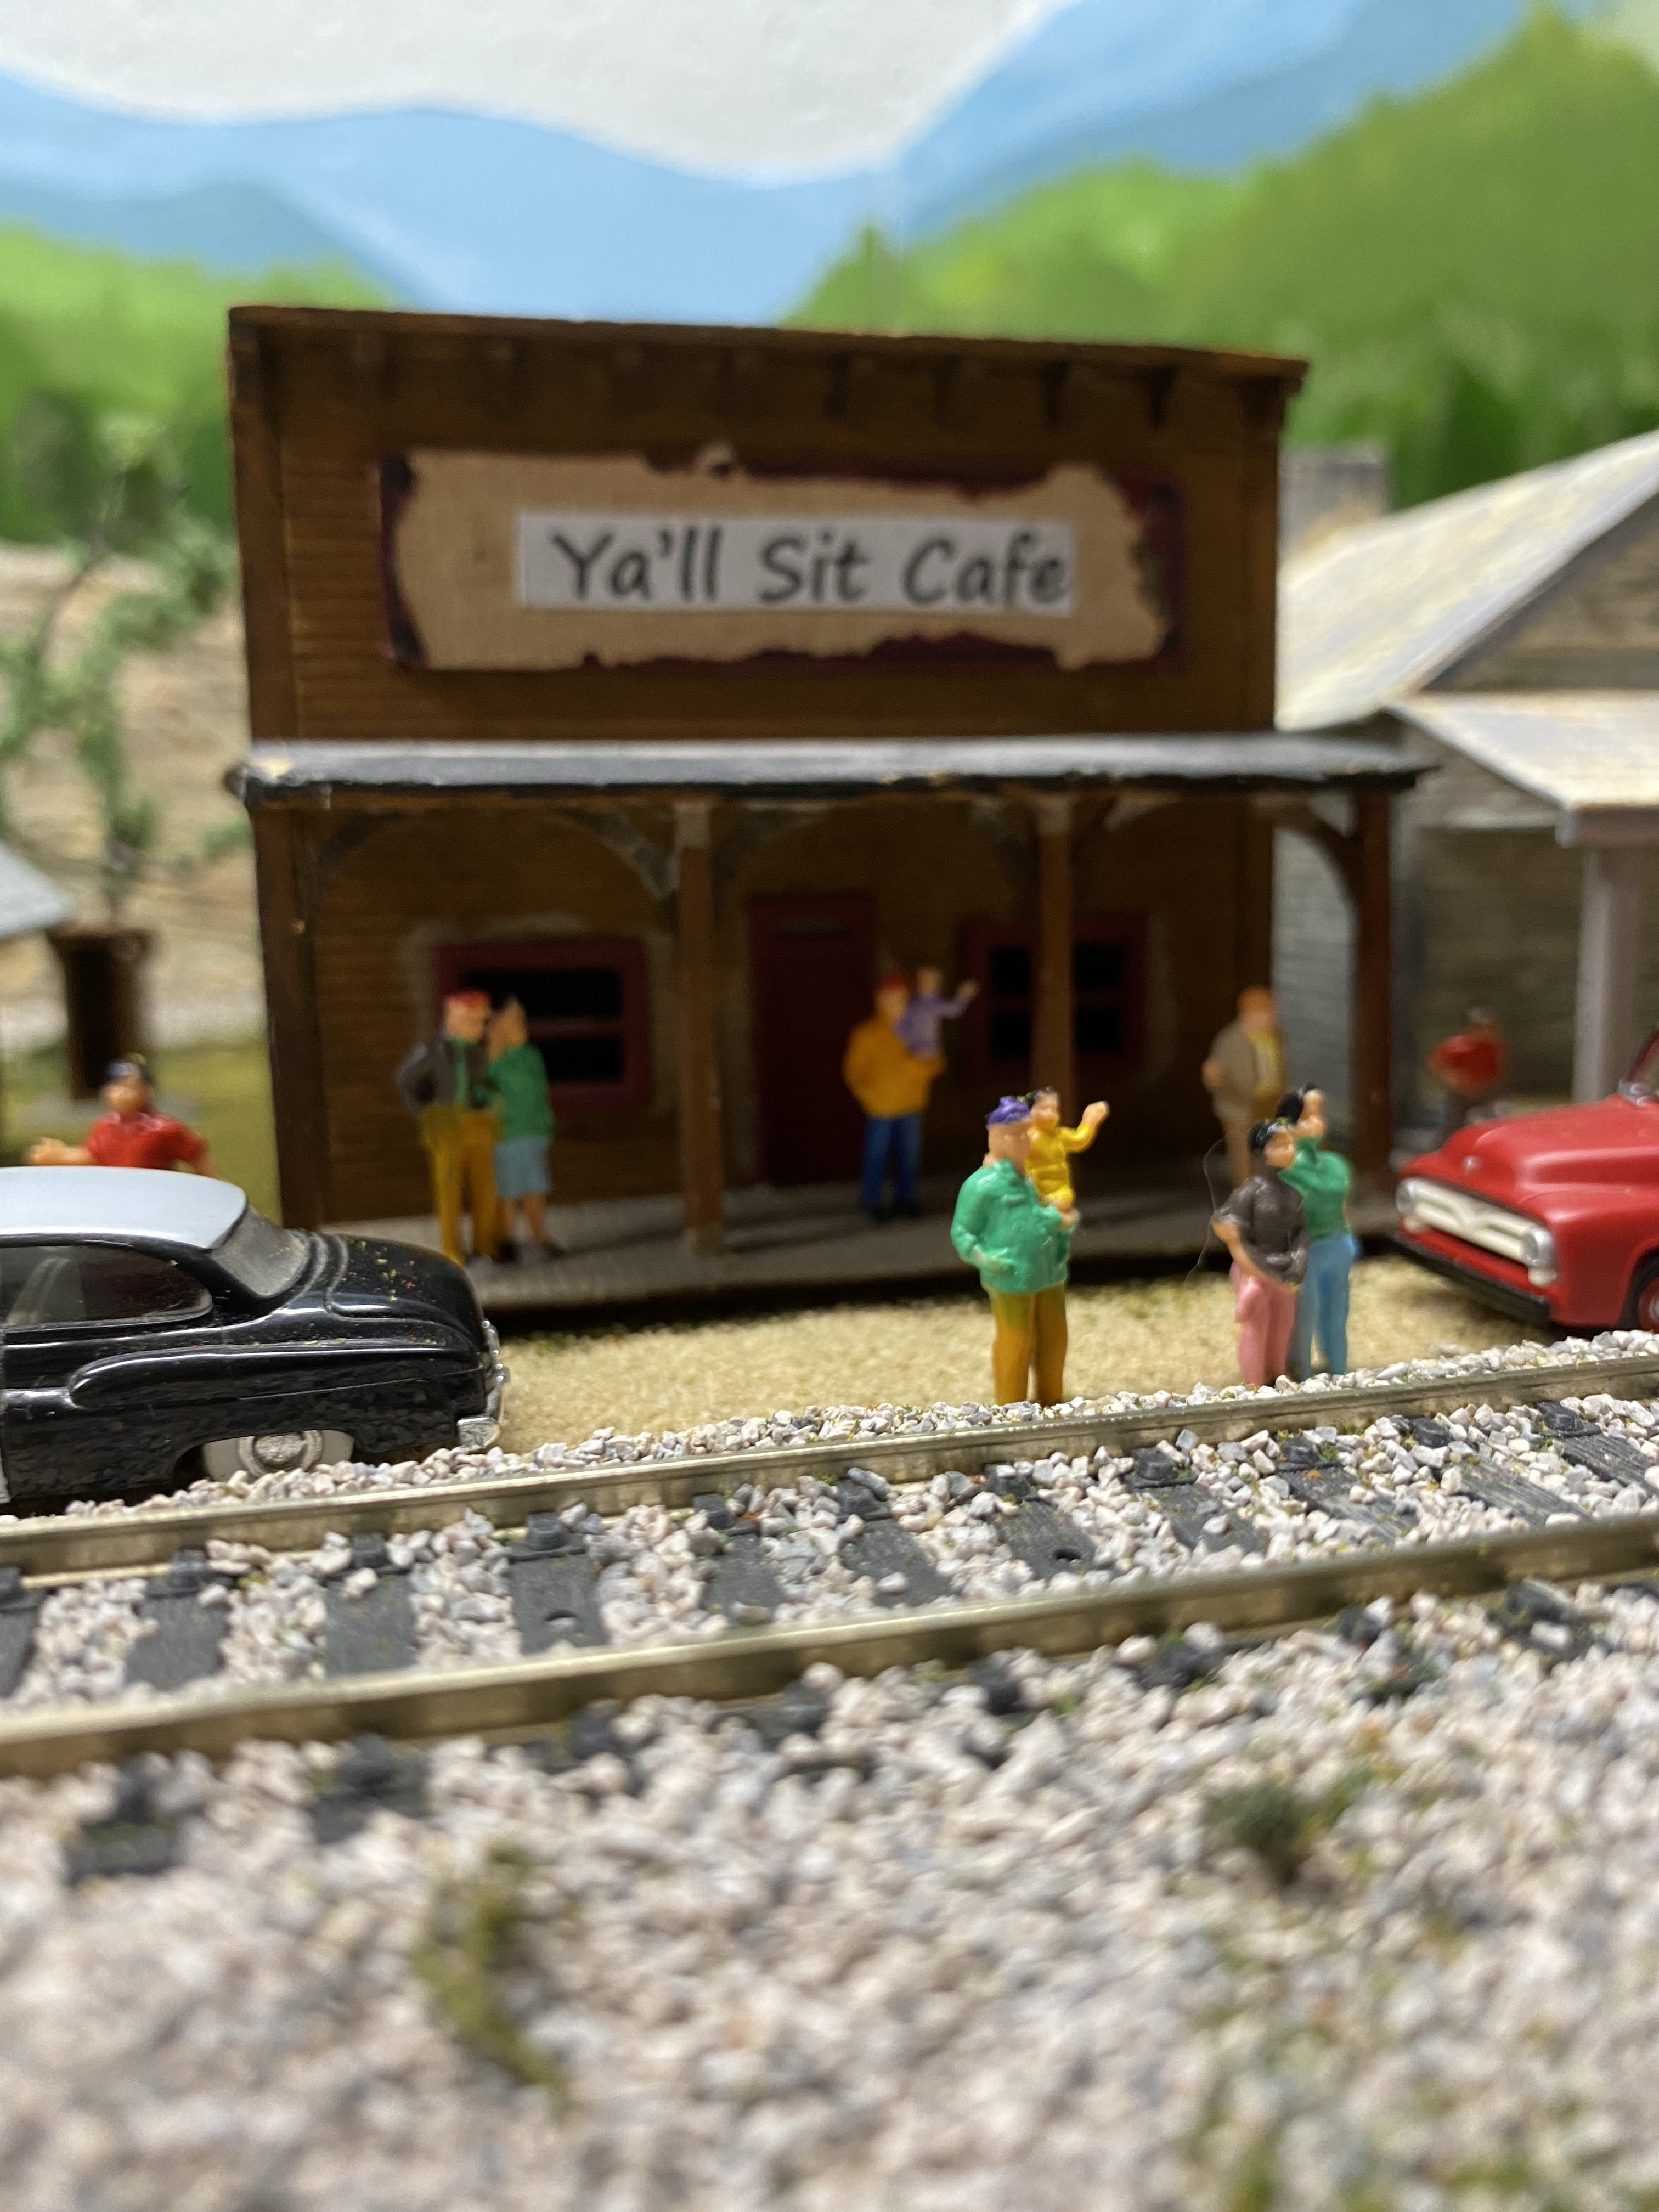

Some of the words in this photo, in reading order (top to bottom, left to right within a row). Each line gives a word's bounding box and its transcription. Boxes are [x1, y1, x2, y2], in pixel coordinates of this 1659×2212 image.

[551, 525, 723, 602] Ya'll
[758, 530, 870, 602] Sit
[902, 530, 1069, 607] Cafe
